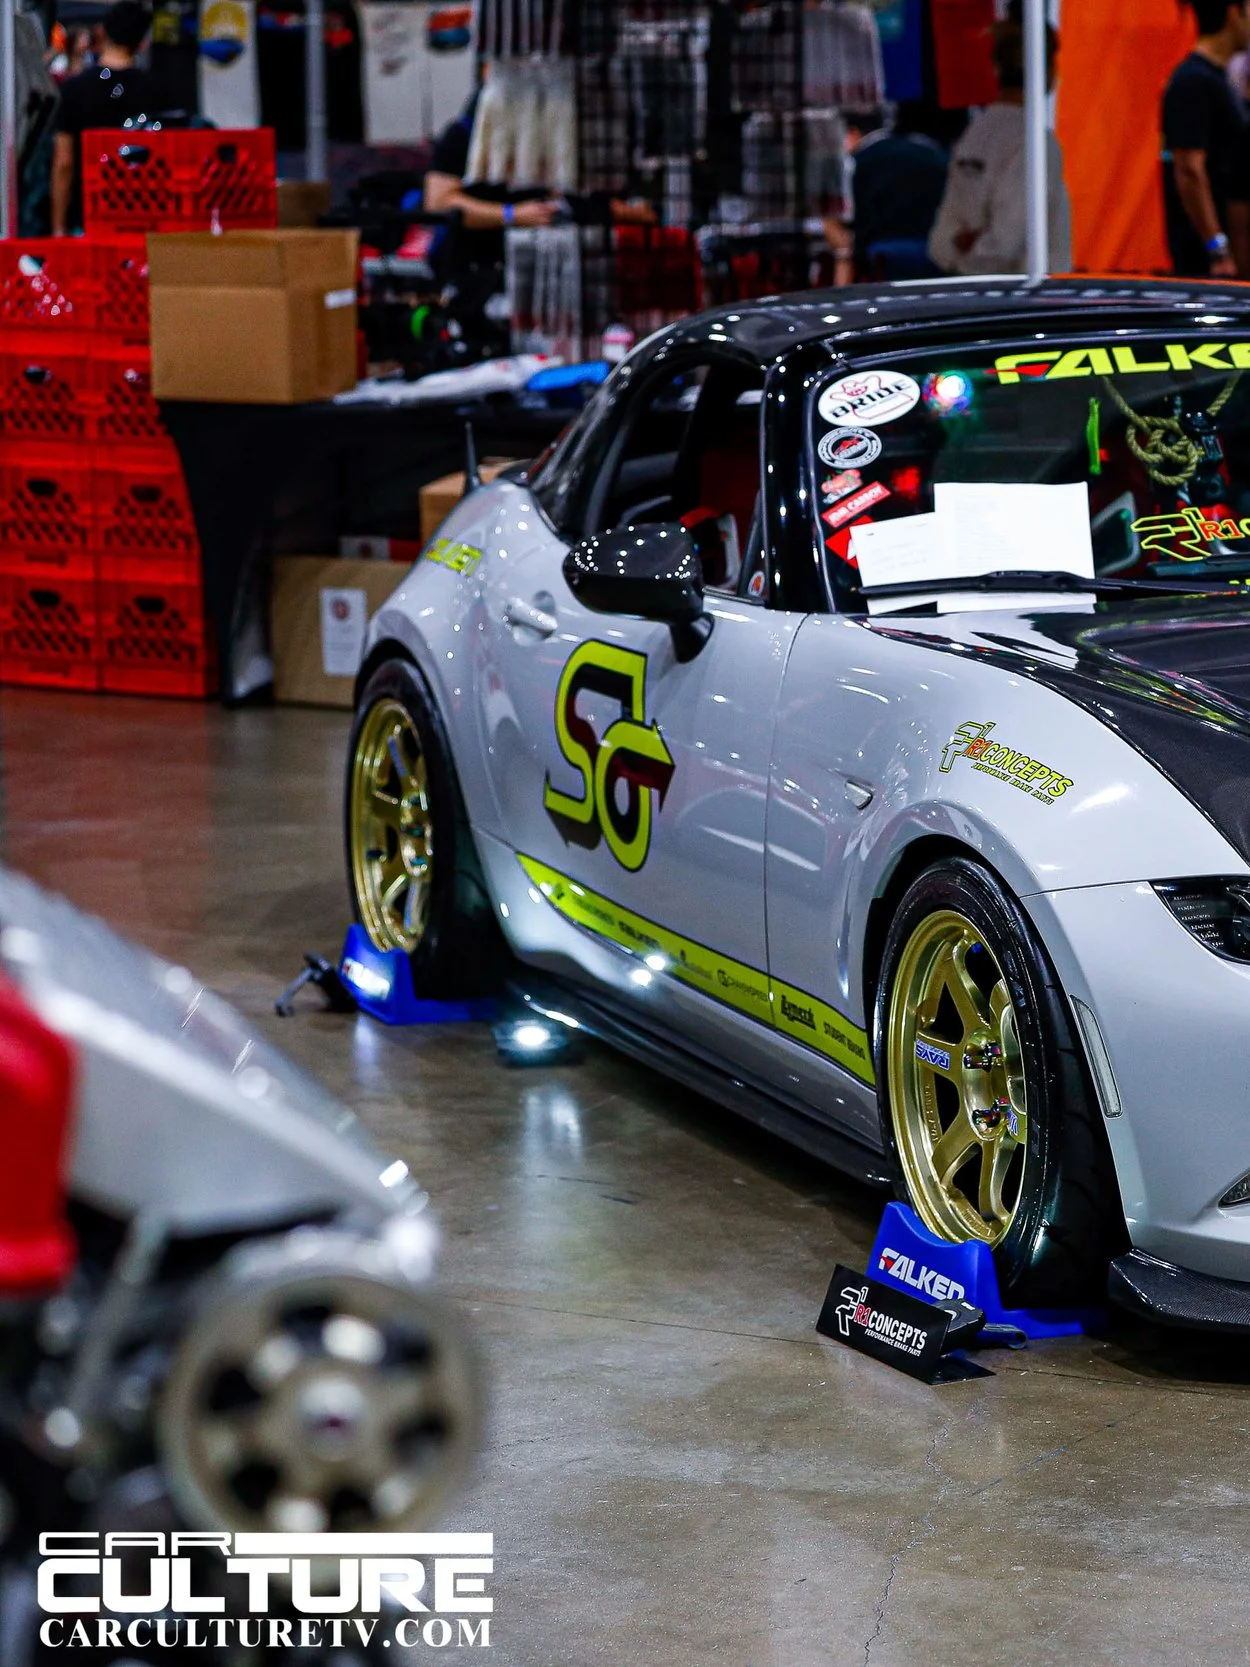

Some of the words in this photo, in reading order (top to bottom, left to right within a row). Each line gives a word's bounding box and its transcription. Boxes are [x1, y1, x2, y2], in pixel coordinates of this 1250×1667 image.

[830, 379, 912, 418] BRIDE
[879, 1247, 965, 1300] FALKEN
[864, 1328, 895, 1346] PERFORMANCE
[893, 1340, 909, 1352] BRAKE
[907, 1346, 921, 1357] PARTS
